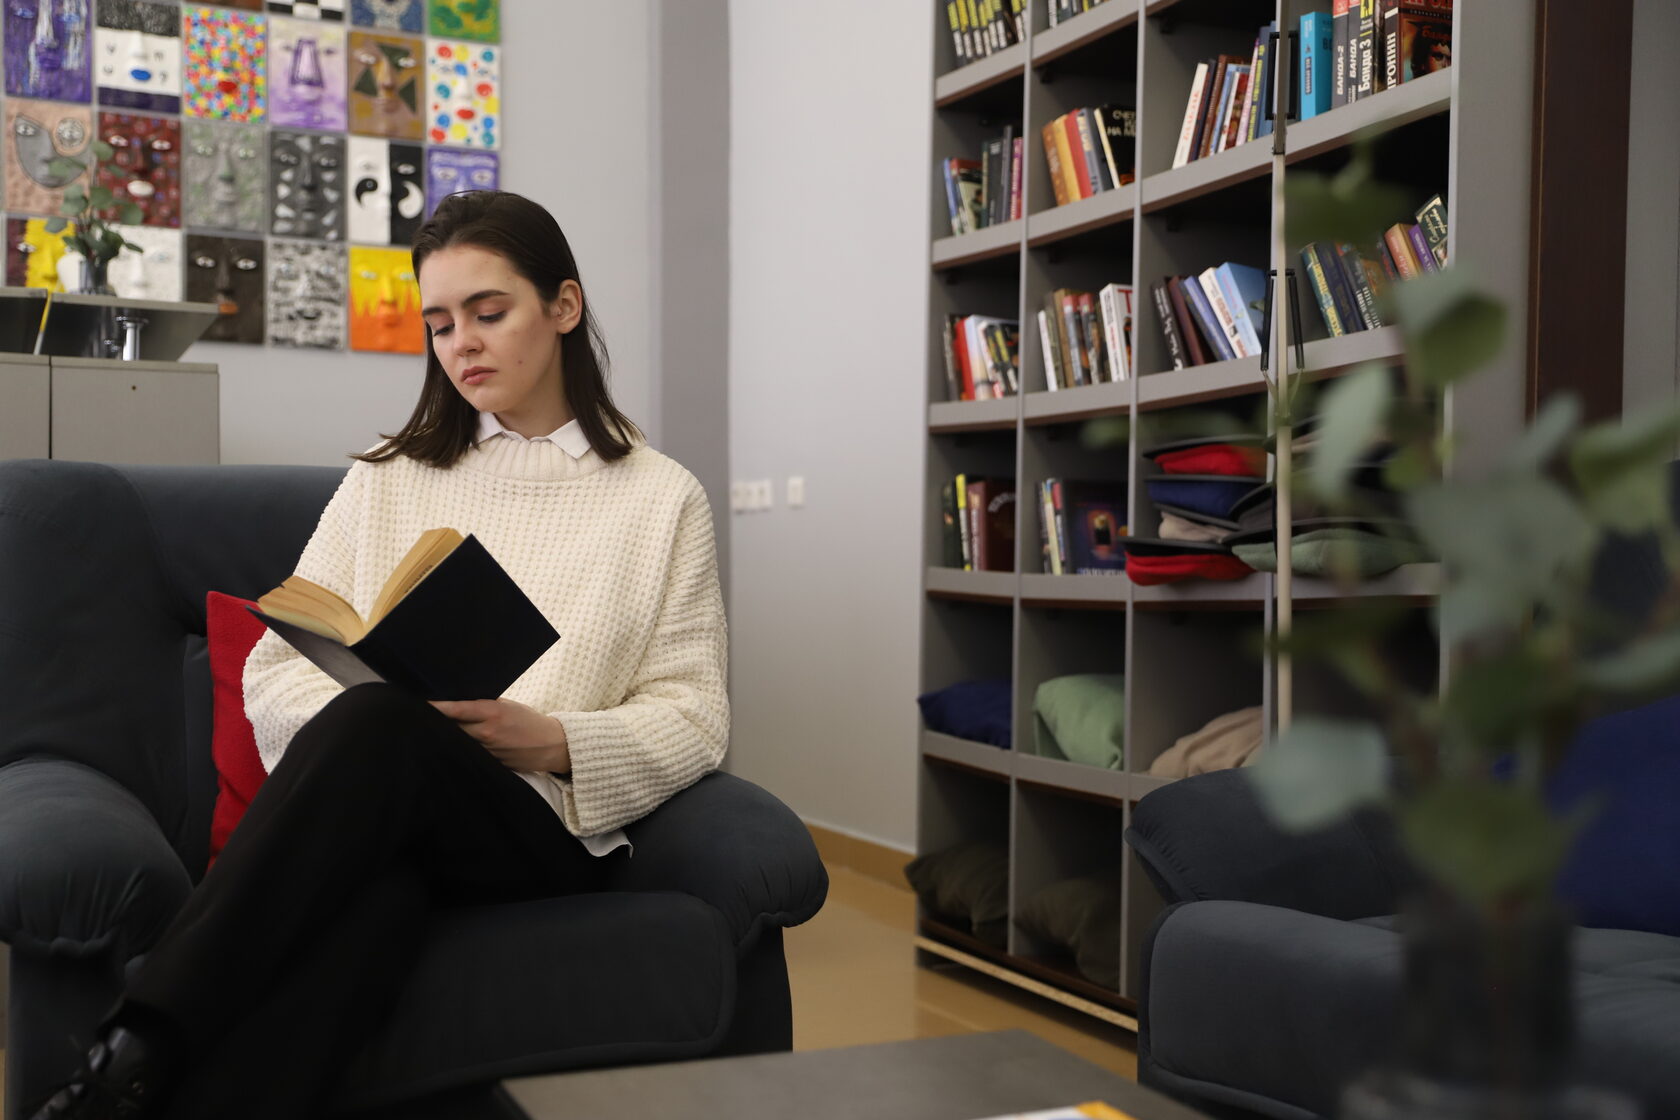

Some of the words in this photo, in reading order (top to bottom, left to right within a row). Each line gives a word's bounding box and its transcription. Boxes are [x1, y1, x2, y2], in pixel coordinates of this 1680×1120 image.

[1350, 38, 1358, 79] БАНДА
[1359, 38, 1372, 49] 3
[1336, 45, 1345, 96] БАНДА-2
[1358, 50, 1373, 92] Банда
